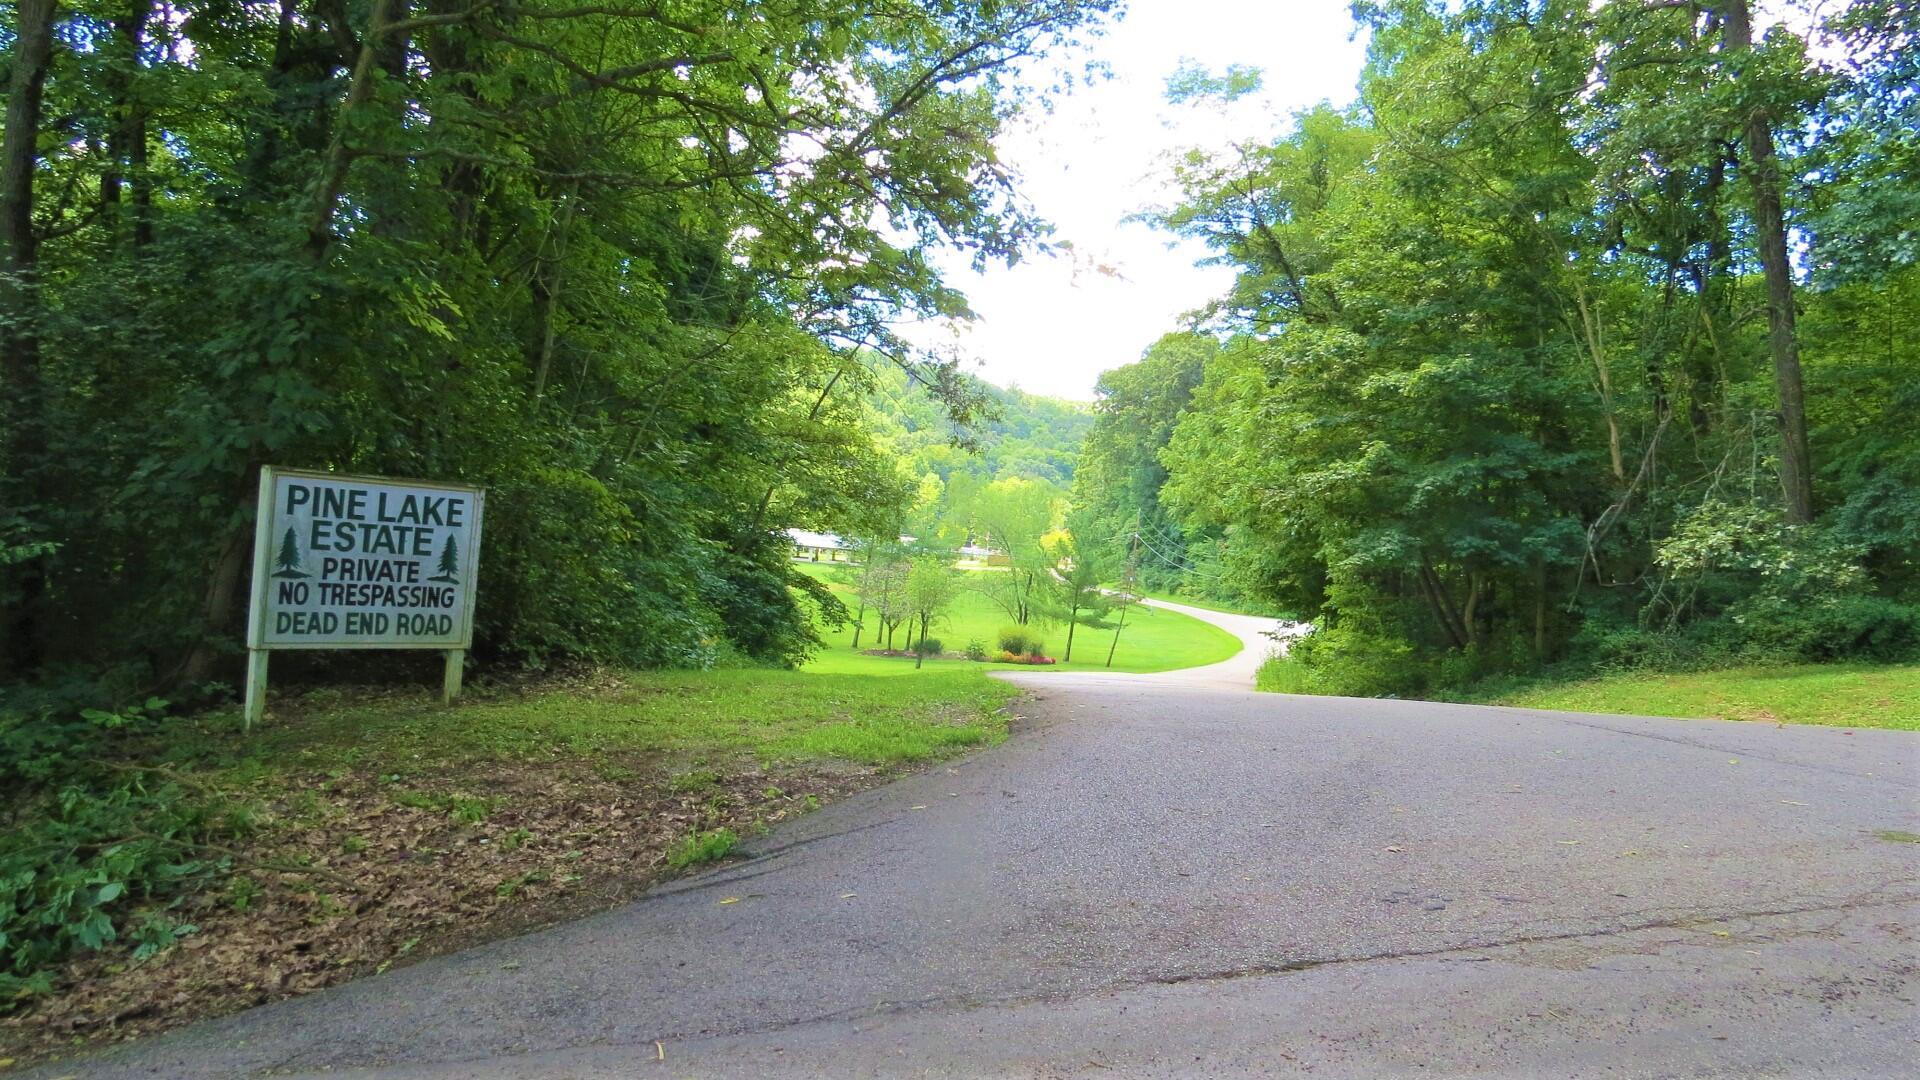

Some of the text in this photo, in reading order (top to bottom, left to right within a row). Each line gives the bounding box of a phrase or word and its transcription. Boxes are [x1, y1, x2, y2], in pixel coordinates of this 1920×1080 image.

[286, 484, 465, 528] PINE LAKE
[310, 520, 435, 557] ESTATE
[321, 557, 420, 583] PRIVATE
[278, 582, 455, 608] NO TRESPASSING
[276, 611, 453, 636] DEAD END ROAD
